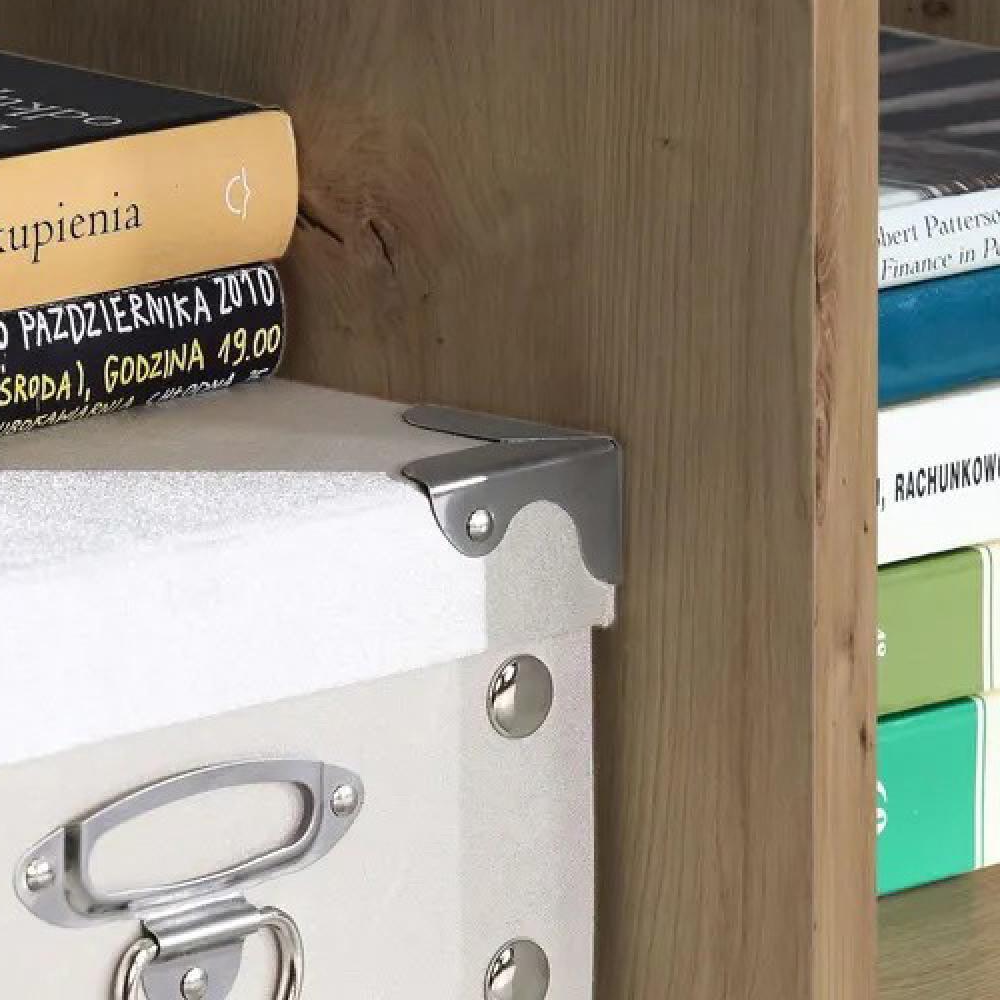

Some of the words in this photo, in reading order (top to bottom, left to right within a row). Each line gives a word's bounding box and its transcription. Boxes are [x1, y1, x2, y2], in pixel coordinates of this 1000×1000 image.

[881, 253, 953, 281] Finance
[959, 247, 975, 265] in
[213, 266, 276, 316] 2010
[103, 337, 204, 394] GODZINA
[218, 324, 280, 367] 19.00
